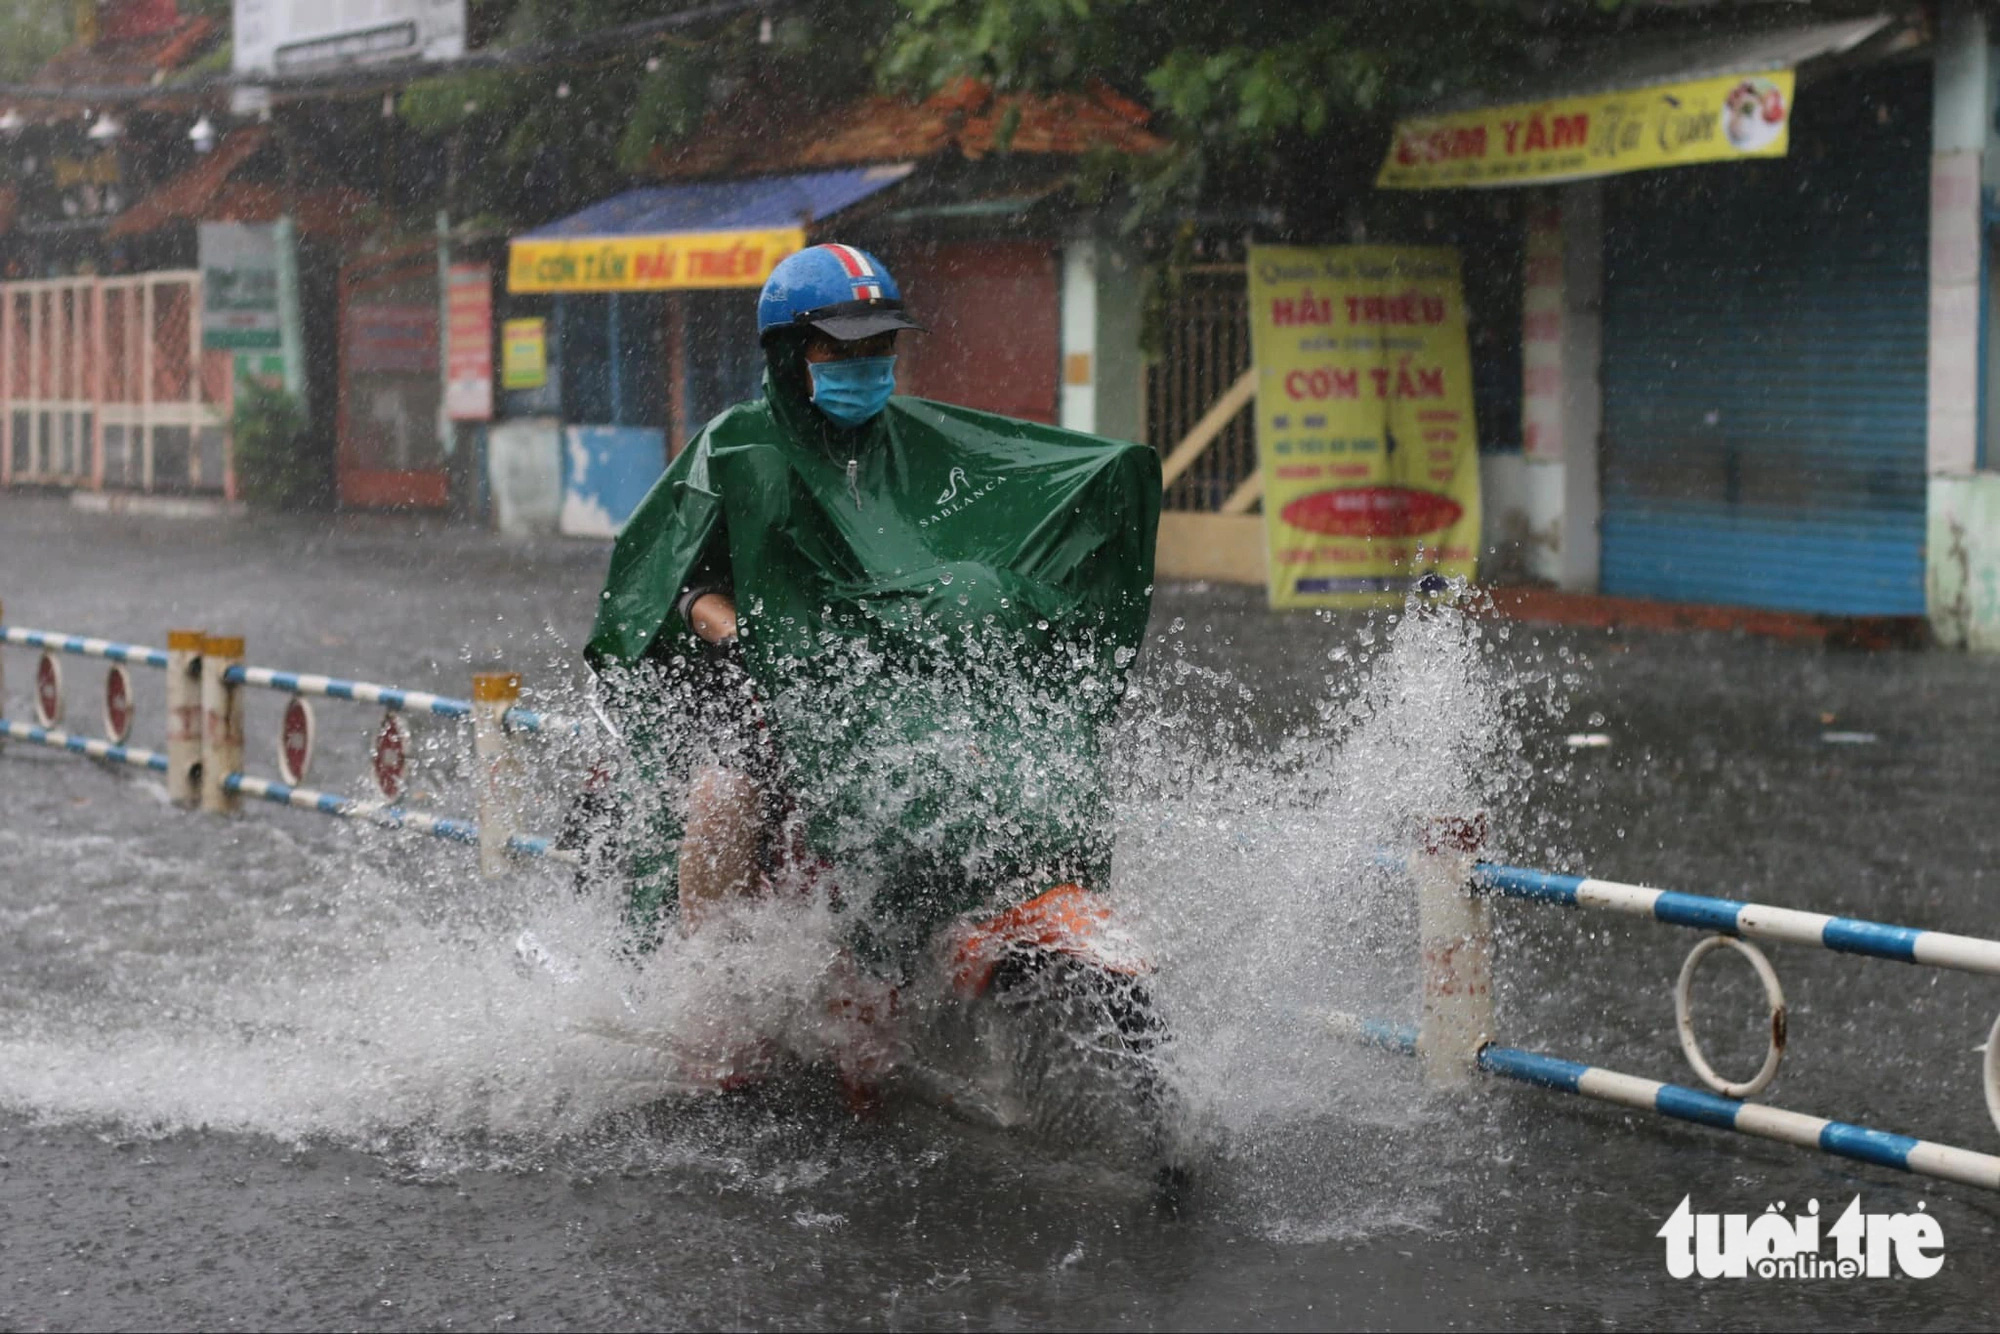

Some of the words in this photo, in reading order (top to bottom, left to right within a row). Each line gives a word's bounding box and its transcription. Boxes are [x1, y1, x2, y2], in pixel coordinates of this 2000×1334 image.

[1284, 364, 1359, 402] CƠM
[1368, 352, 1446, 400] TẤM
[919, 475, 1008, 528] SABLANCA
